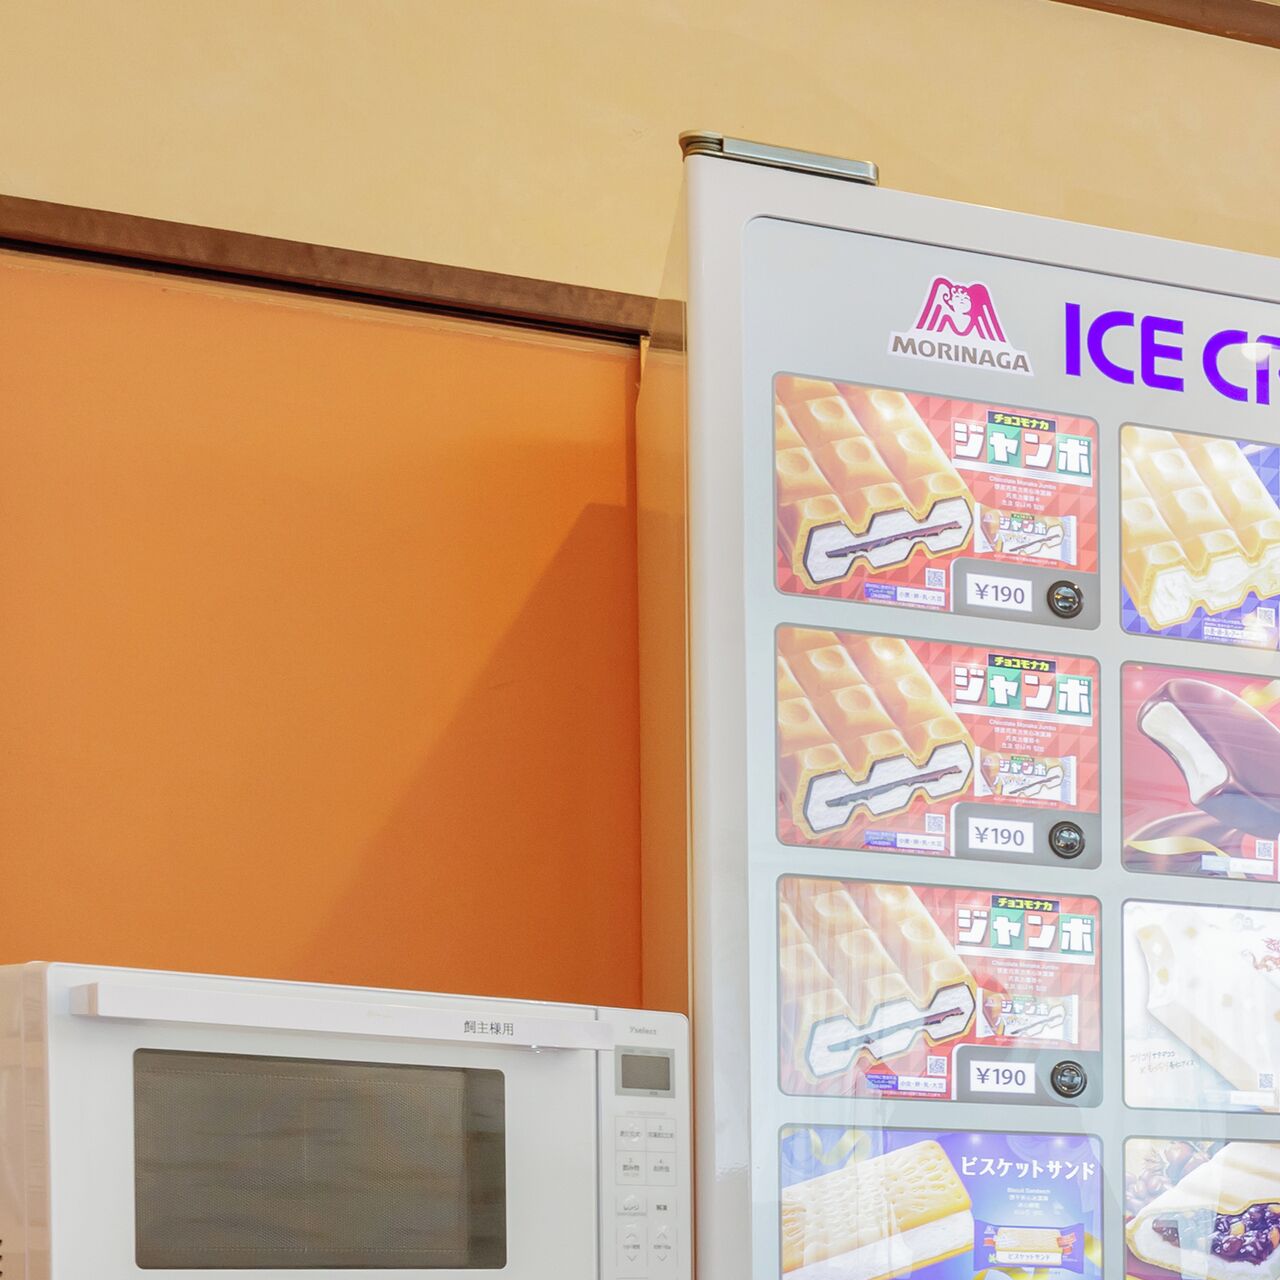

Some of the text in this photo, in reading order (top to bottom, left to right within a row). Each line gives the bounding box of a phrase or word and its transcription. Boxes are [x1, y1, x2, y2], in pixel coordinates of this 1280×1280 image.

[891, 336, 1030, 373] MORINAGA
[1065, 302, 1184, 392] ICE
[994, 413, 1050, 430] チョコモナカ
[954, 422, 1090, 474] ジャンボ
[975, 583, 1025, 604] ¥190
[994, 656, 1049, 672] チョコモナカ
[955, 666, 1089, 714] ジャンボ
[976, 827, 1024, 846] ¥190
[998, 898, 1053, 911] チョコモナカ
[958, 909, 1094, 953] ジャンボ
[977, 1067, 1026, 1086] ¥190
[961, 1156, 1096, 1181] ビスケットサンド
